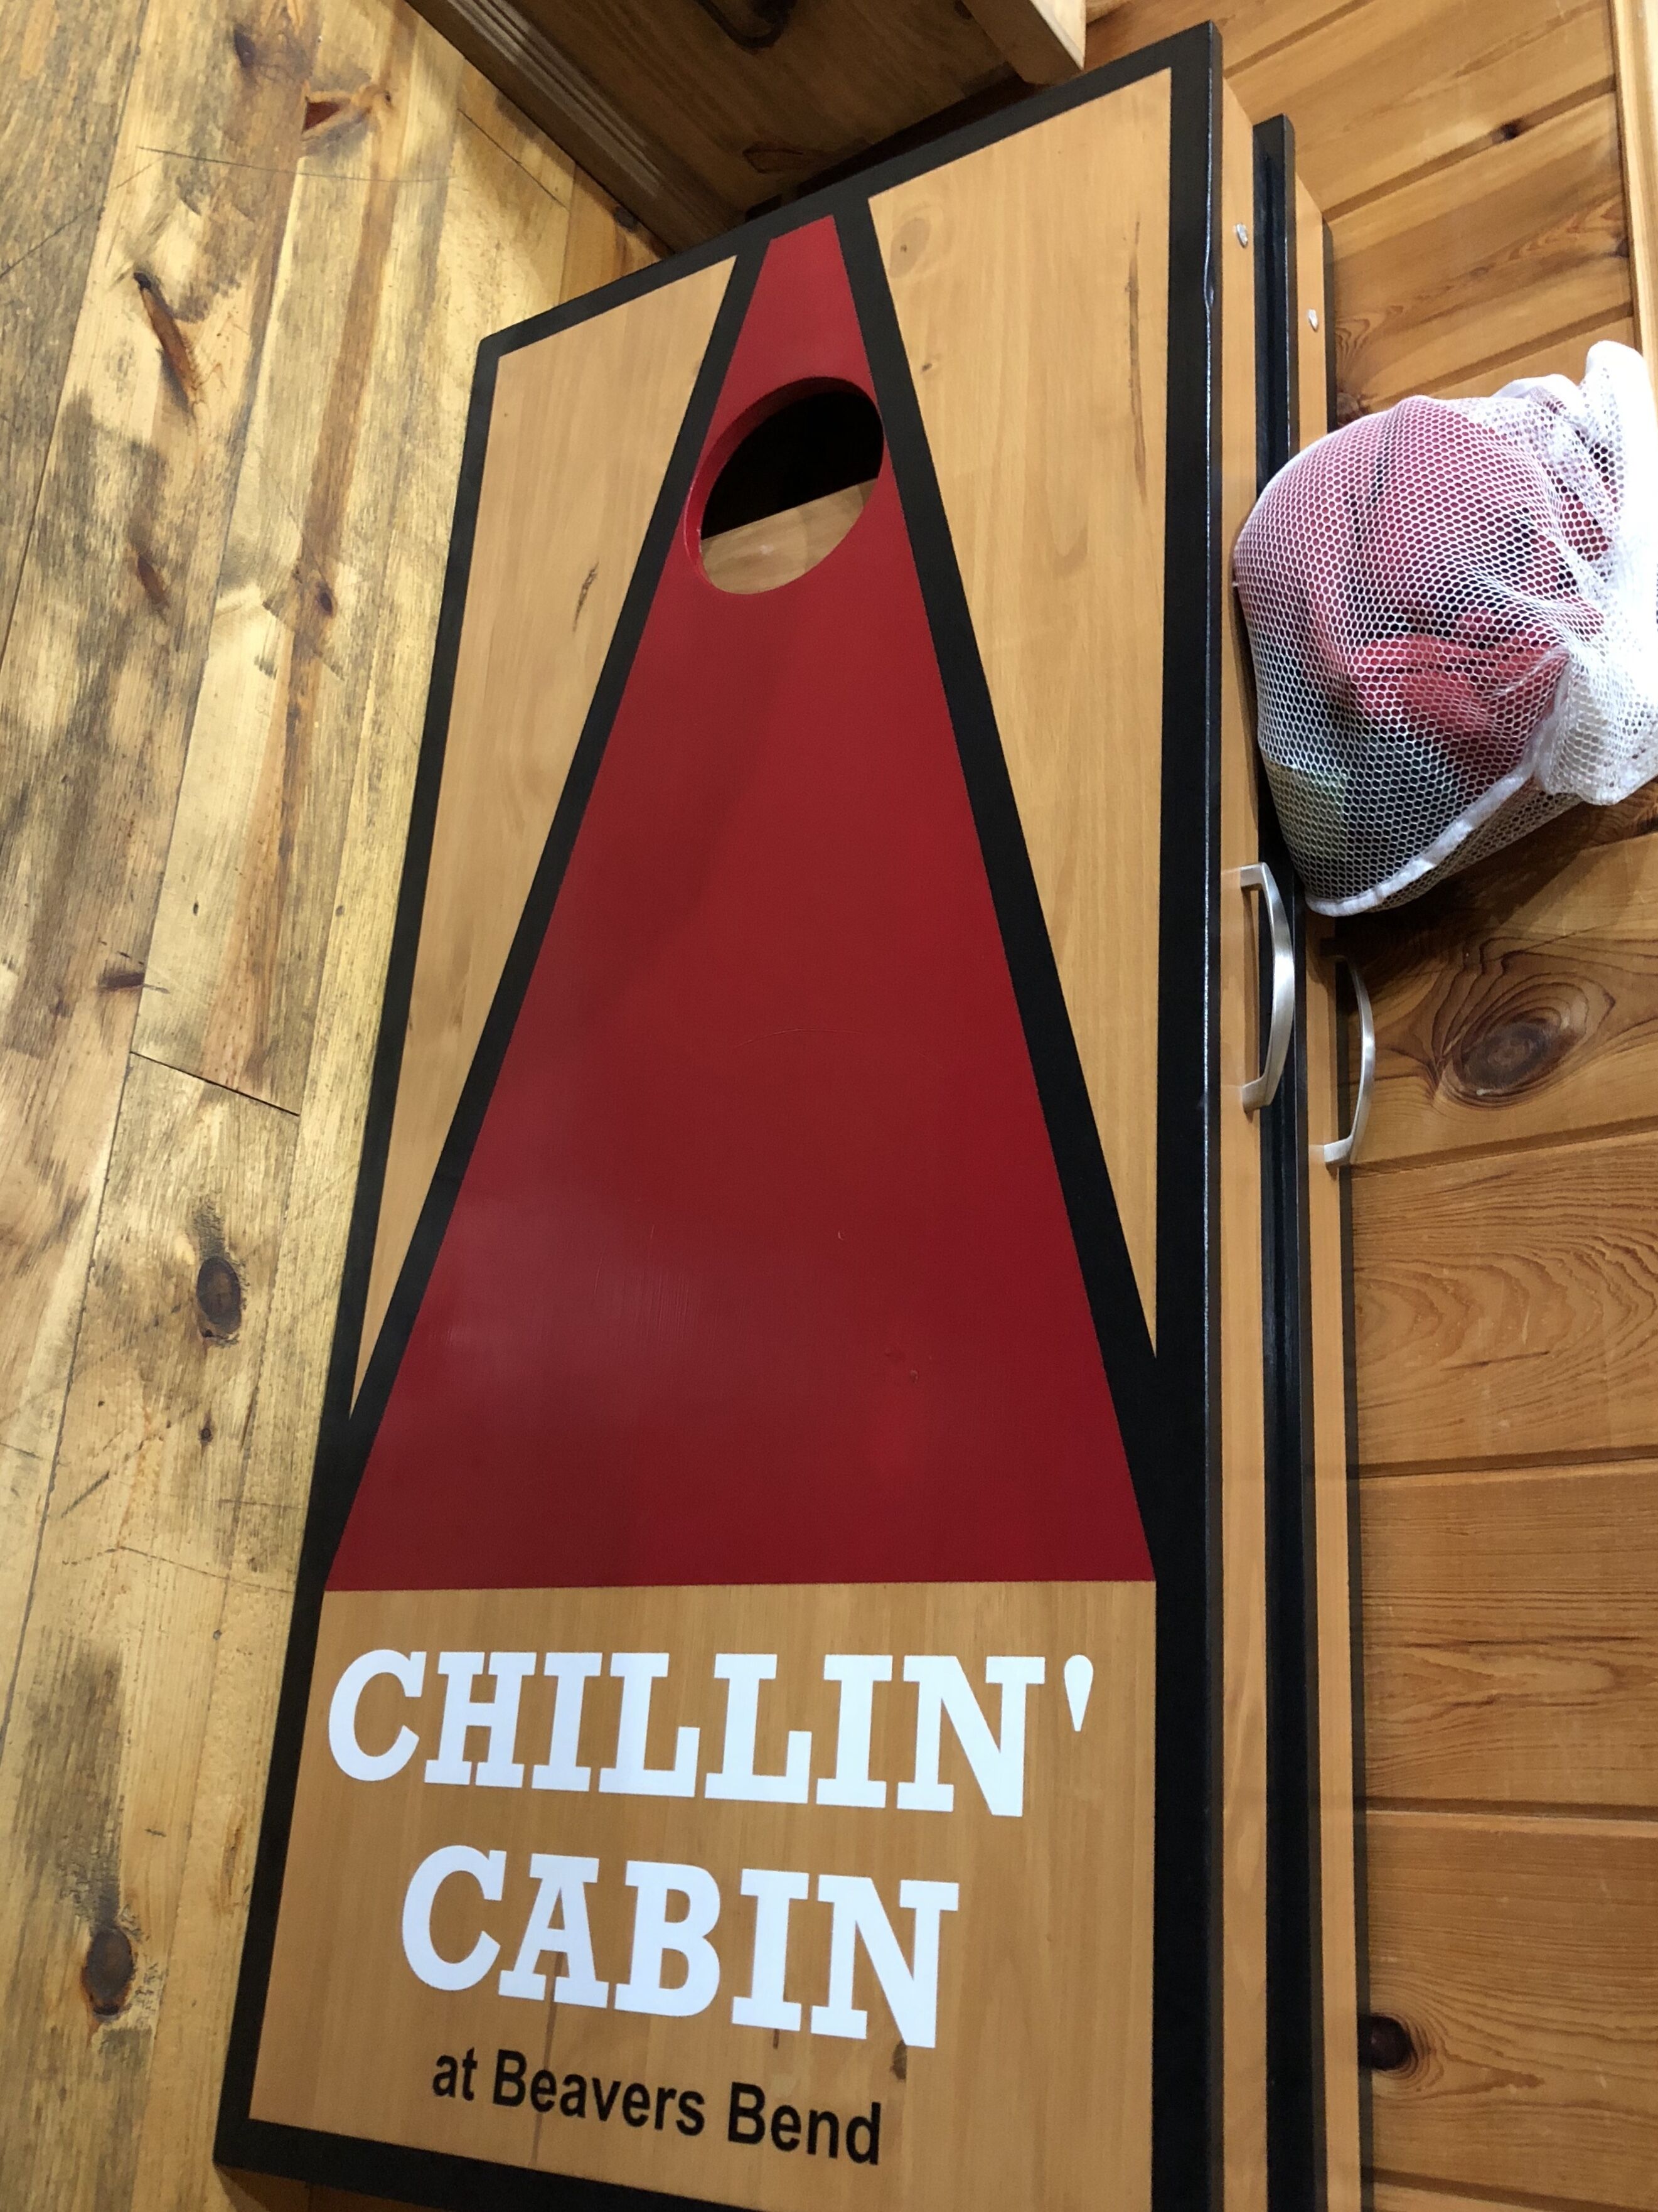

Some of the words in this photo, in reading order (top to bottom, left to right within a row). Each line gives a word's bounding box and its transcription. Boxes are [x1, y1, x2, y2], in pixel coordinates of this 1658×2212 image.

[328, 1648, 1094, 1817] CHILLIN'
[401, 1844, 960, 2048] CABIN
[432, 2047, 478, 2102] at
[492, 2048, 705, 2137] Beavers
[727, 2081, 882, 2166] Bend
